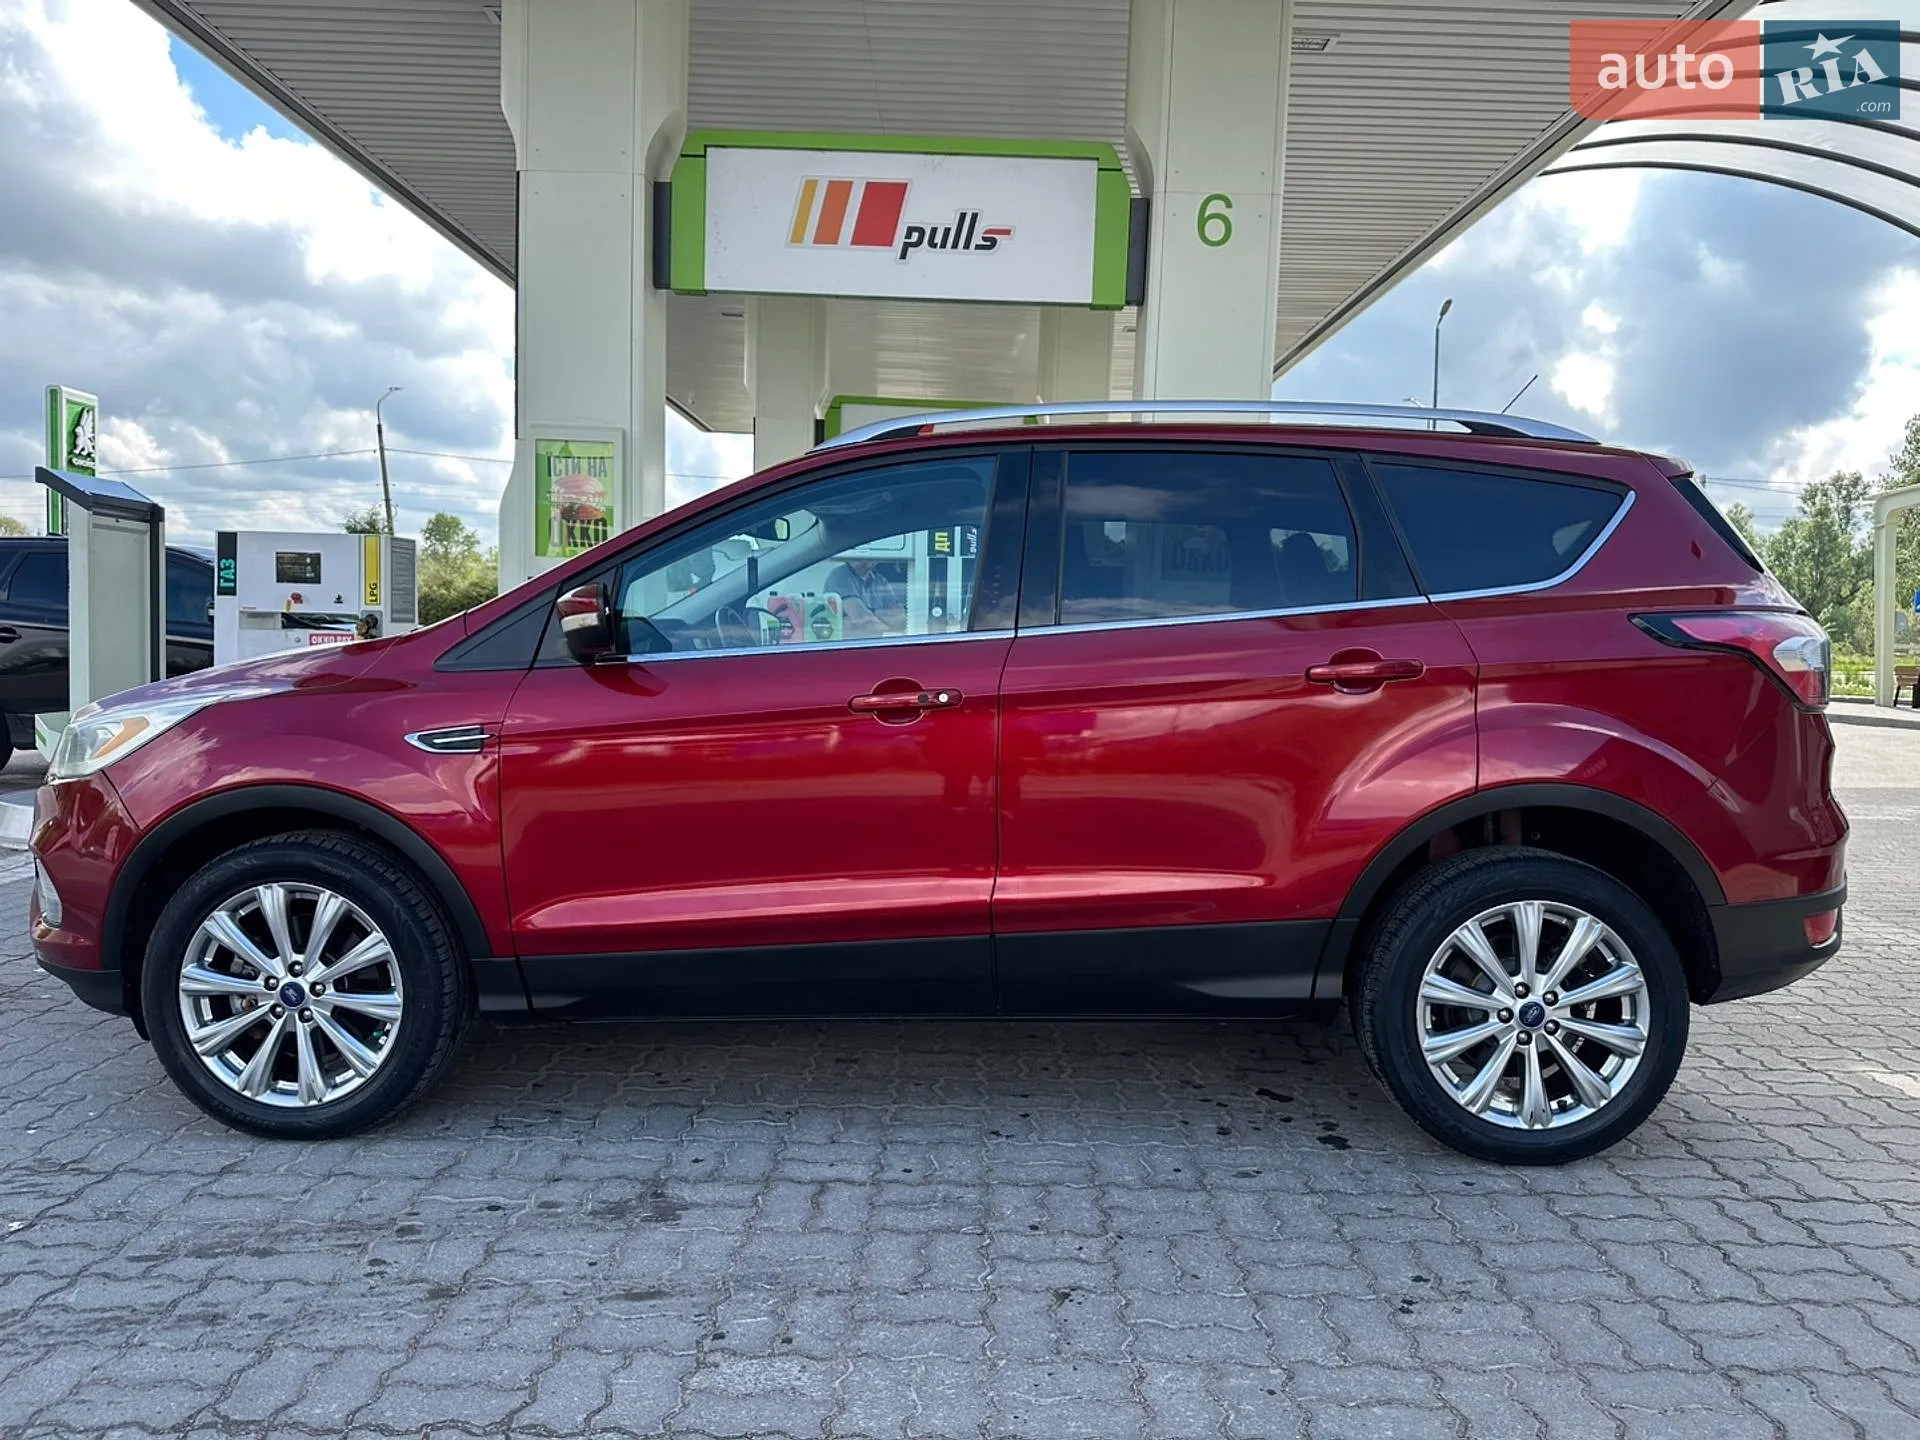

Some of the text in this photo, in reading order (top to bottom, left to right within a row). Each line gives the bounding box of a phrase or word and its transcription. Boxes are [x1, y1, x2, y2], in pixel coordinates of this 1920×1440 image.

[1197, 193, 1233, 247] 6
[899, 211, 1012, 260] pulls
[588, 456, 608, 477] НА
[934, 532, 951, 552] ДП
[219, 558, 235, 588] ГАЗ
[369, 582, 377, 603] LPG
